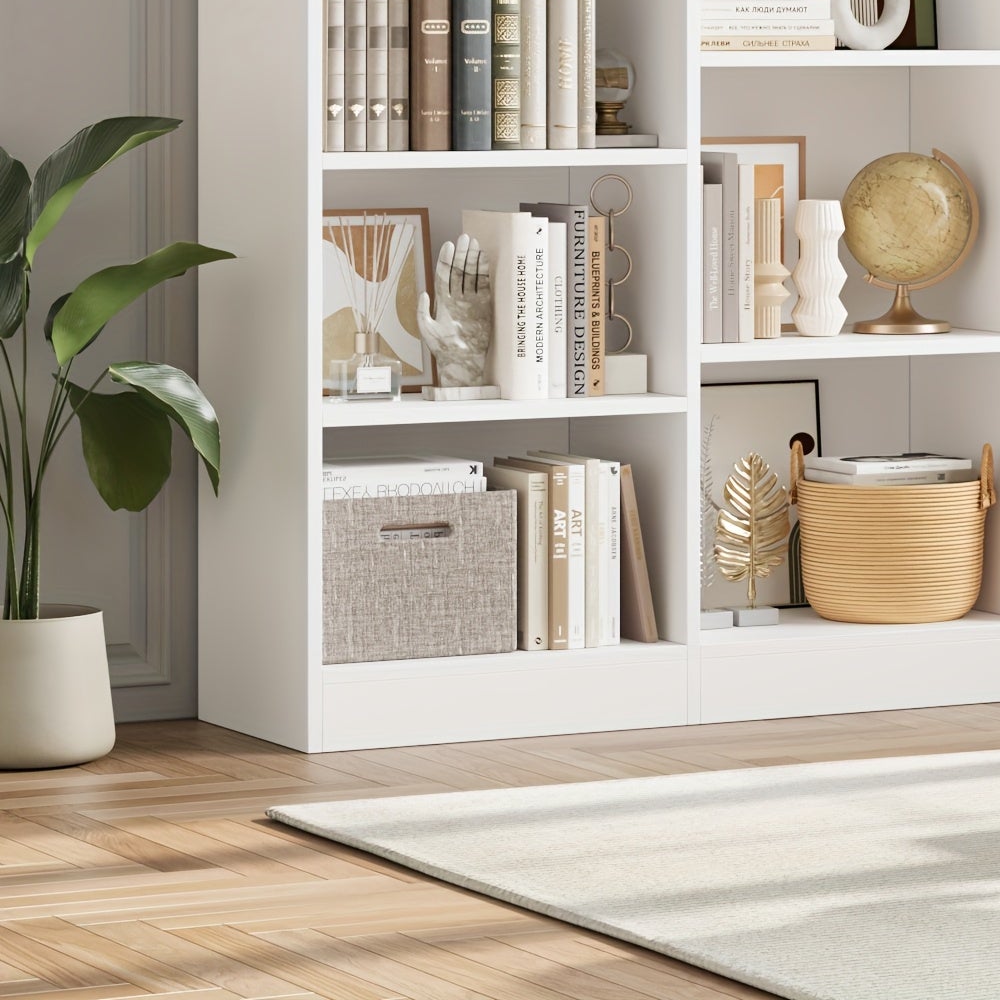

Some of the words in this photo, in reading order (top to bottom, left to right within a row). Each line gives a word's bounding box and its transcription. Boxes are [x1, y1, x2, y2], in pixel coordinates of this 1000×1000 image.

[751, 6, 775, 15] ЛЮДИ
[776, 6, 808, 15] ДУМАЮТ
[742, 39, 779, 47] СИЛЬНЕЕ
[782, 39, 811, 47] СТРАХА
[424, 57, 449, 65] Volume
[463, 57, 488, 65] Volume
[708, 226, 720, 250] Home
[516, 254, 526, 276] HOME
[572, 209, 586, 321] FURNITURE
[743, 258, 753, 281] Story
[516, 277, 526, 303] HOUSE
[534, 246, 544, 320] ARCHITECTURE
[590, 250, 600, 309] BLUEPRINTS
[727, 269, 737, 296] Home
[552, 275, 563, 334] CLOTHING
[708, 295, 719, 310] The
[743, 281, 752, 310] House
[516, 303, 526, 320] THE
[590, 311, 599, 319] &
[516, 321, 526, 358] BRINGING
[534, 321, 544, 363] MODERN
[590, 320, 600, 371] BUILDINGS
[572, 325, 586, 396] DESIGN
[552, 508, 567, 540] ART
[570, 509, 583, 538] ART
